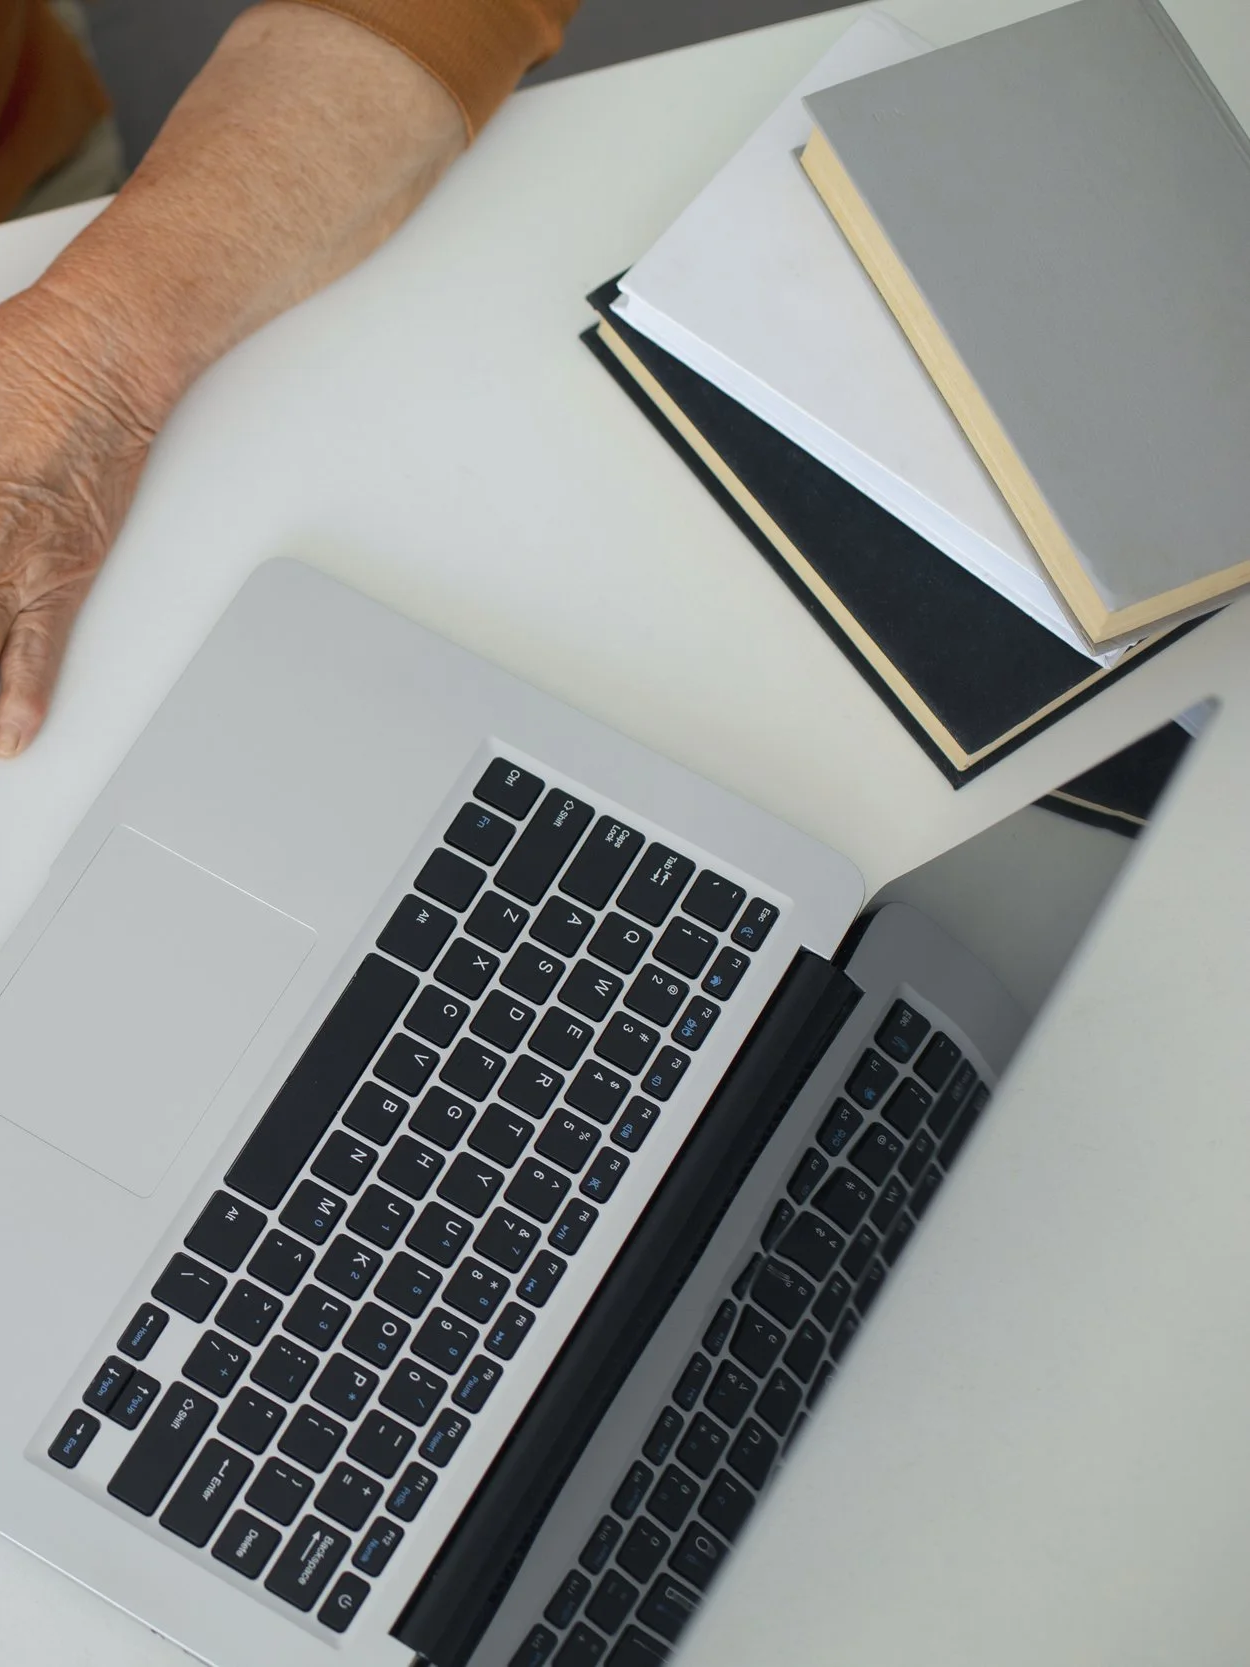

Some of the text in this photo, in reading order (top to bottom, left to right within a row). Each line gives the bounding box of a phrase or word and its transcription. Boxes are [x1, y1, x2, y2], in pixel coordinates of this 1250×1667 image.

[504, 769, 521, 787] Ctrl
[476, 815, 491, 829] Fn
[552, 809, 569, 828] Shift
[604, 824, 621, 843] Lock
[613, 824, 631, 849] Caps
[663, 855, 678, 870] Tab
[415, 908, 430, 924] Alt
[502, 907, 520, 923] Z
[566, 912, 583, 926] A
[757, 907, 772, 923] Esc
[622, 930, 640, 944] Q
[472, 955, 490, 972] X
[538, 960, 554, 974] S
[731, 957, 742, 969] F1
[651, 974, 664, 985] 2
[594, 978, 613, 997] W
[666, 984, 679, 996] @
[443, 1003, 458, 1018] C
[509, 1006, 526, 1022] D
[701, 1007, 713, 1019] F2
[566, 1023, 584, 1040] E
[622, 1023, 634, 1033] 3
[639, 1032, 650, 1043] #
[413, 1053, 430, 1067] V
[481, 1055, 495, 1070] F
[670, 1057, 683, 1069] F3
[535, 1072, 554, 1088] R
[592, 1071, 604, 1082] 4
[609, 1080, 621, 1090] $
[382, 1098, 399, 1113] B
[446, 1105, 463, 1120] G
[641, 1107, 652, 1120] F4
[508, 1124, 524, 1137] T
[563, 1120, 575, 1131] 5
[578, 1130, 591, 1142] %
[349, 1147, 368, 1164] N
[416, 1152, 435, 1169] H
[609, 1159, 621, 1172] F5
[476, 1174, 493, 1188] Y
[533, 1170, 545, 1180] 6
[224, 1205, 239, 1222] Alt
[317, 1197, 337, 1216] M
[387, 1202, 401, 1216] J
[578, 1210, 591, 1222] F6
[445, 1220, 463, 1236] U
[503, 1219, 516, 1231] 7
[517, 1228, 531, 1239] &
[293, 1253, 302, 1262] <
[350, 1251, 371, 1280] K 2
[547, 1262, 559, 1275] F7
[416, 1270, 431, 1280] I
[471, 1269, 484, 1280] 8
[263, 1301, 272, 1312] >
[321, 1301, 339, 1312] L
[440, 1319, 453, 1331] 9
[515, 1314, 527, 1327] F8
[381, 1321, 398, 1337] O
[131, 1327, 148, 1346] Home
[448, 1330, 468, 1357] ( 9
[210, 1340, 221, 1351] /
[227, 1352, 239, 1363] ?
[353, 1371, 368, 1388] P
[408, 1370, 421, 1382] 0
[482, 1368, 495, 1381] F9
[96, 1376, 114, 1397] PgDn
[425, 1381, 437, 1390] )
[460, 1375, 479, 1398] Pause
[126, 1394, 143, 1415] PgUp
[170, 1409, 188, 1430] Shift
[447, 1420, 462, 1438] F10
[62, 1437, 78, 1455] End
[201, 1476, 222, 1502] Enter
[414, 1475, 429, 1492] F11
[235, 1528, 259, 1558] Delete
[381, 1529, 396, 1546] F12
[297, 1535, 335, 1586] Backspace
